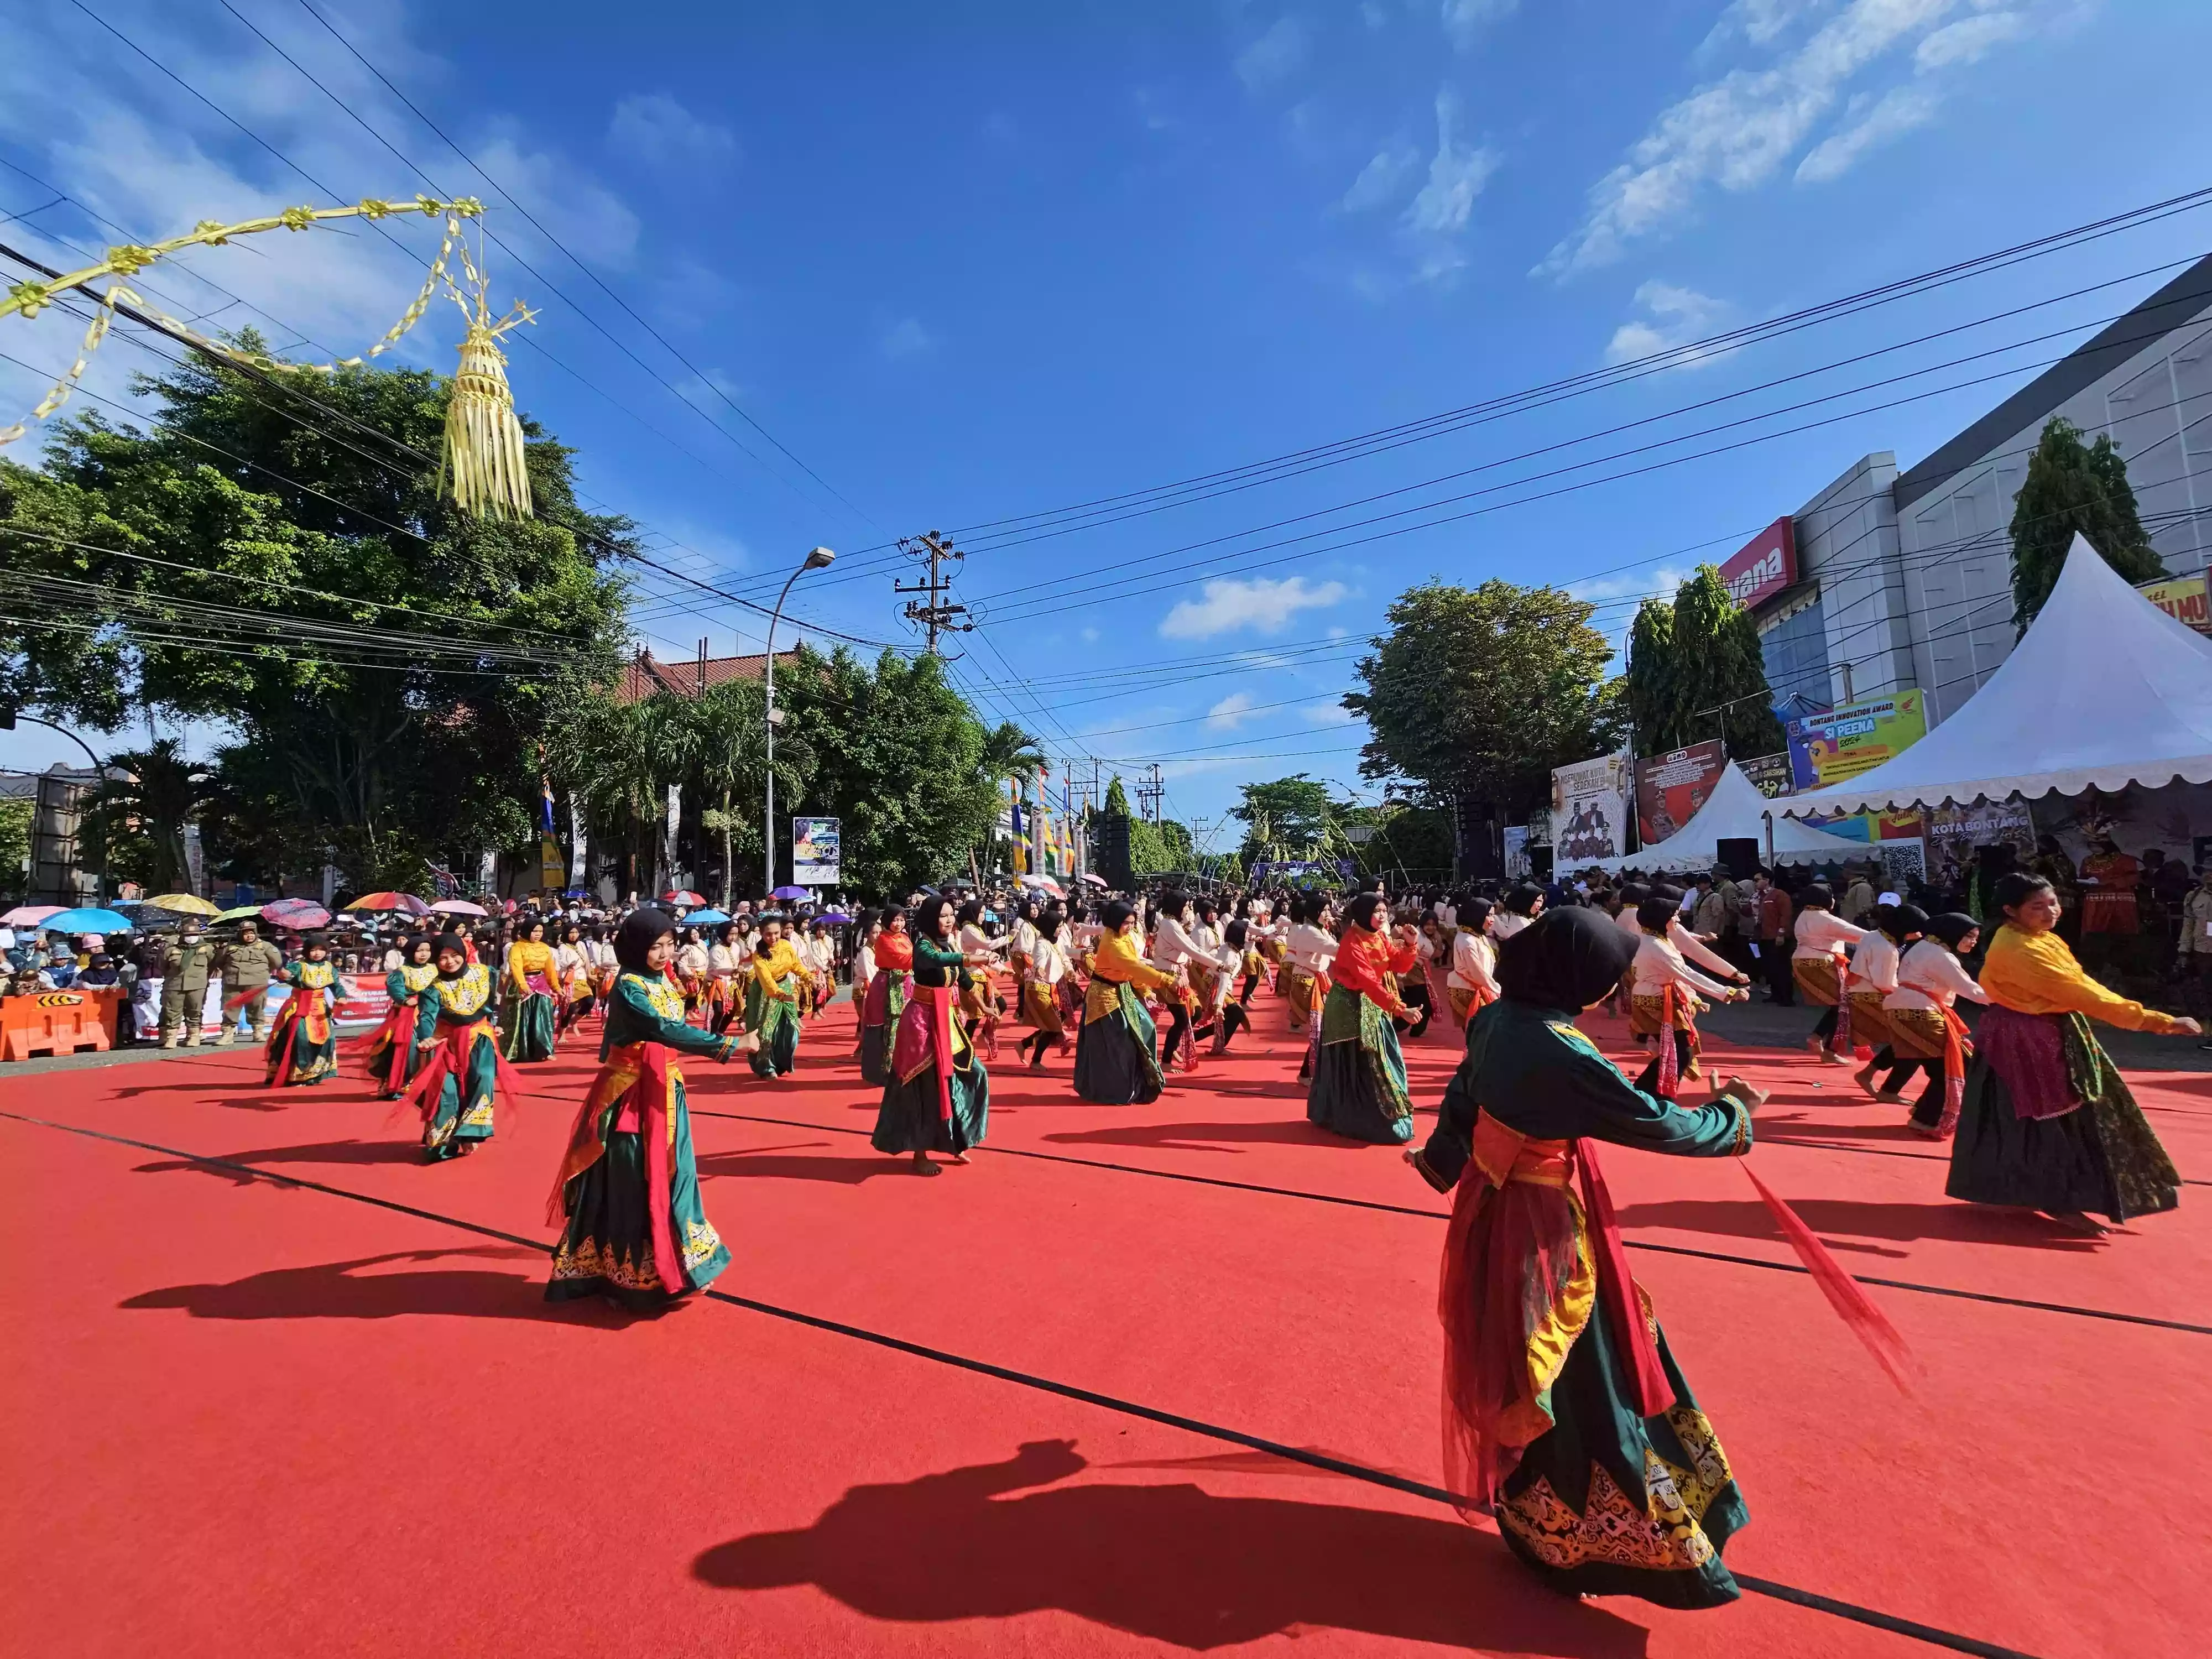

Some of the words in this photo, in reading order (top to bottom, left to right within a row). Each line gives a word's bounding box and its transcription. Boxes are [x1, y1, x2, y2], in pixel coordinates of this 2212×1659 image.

[1810, 716, 1834, 727] BONTANG
[1836, 707, 1870, 721] INNOVATION
[1872, 702, 1893, 713] AWARD
[1825, 727, 1835, 739] SI
[1838, 719, 1875, 737] PEENA
[1839, 734, 1861, 748] 2024
[1574, 777, 1599, 792] SEDEKAH
[1932, 823, 1965, 834] KOTA
[1965, 816, 2028, 832] BONTANG
